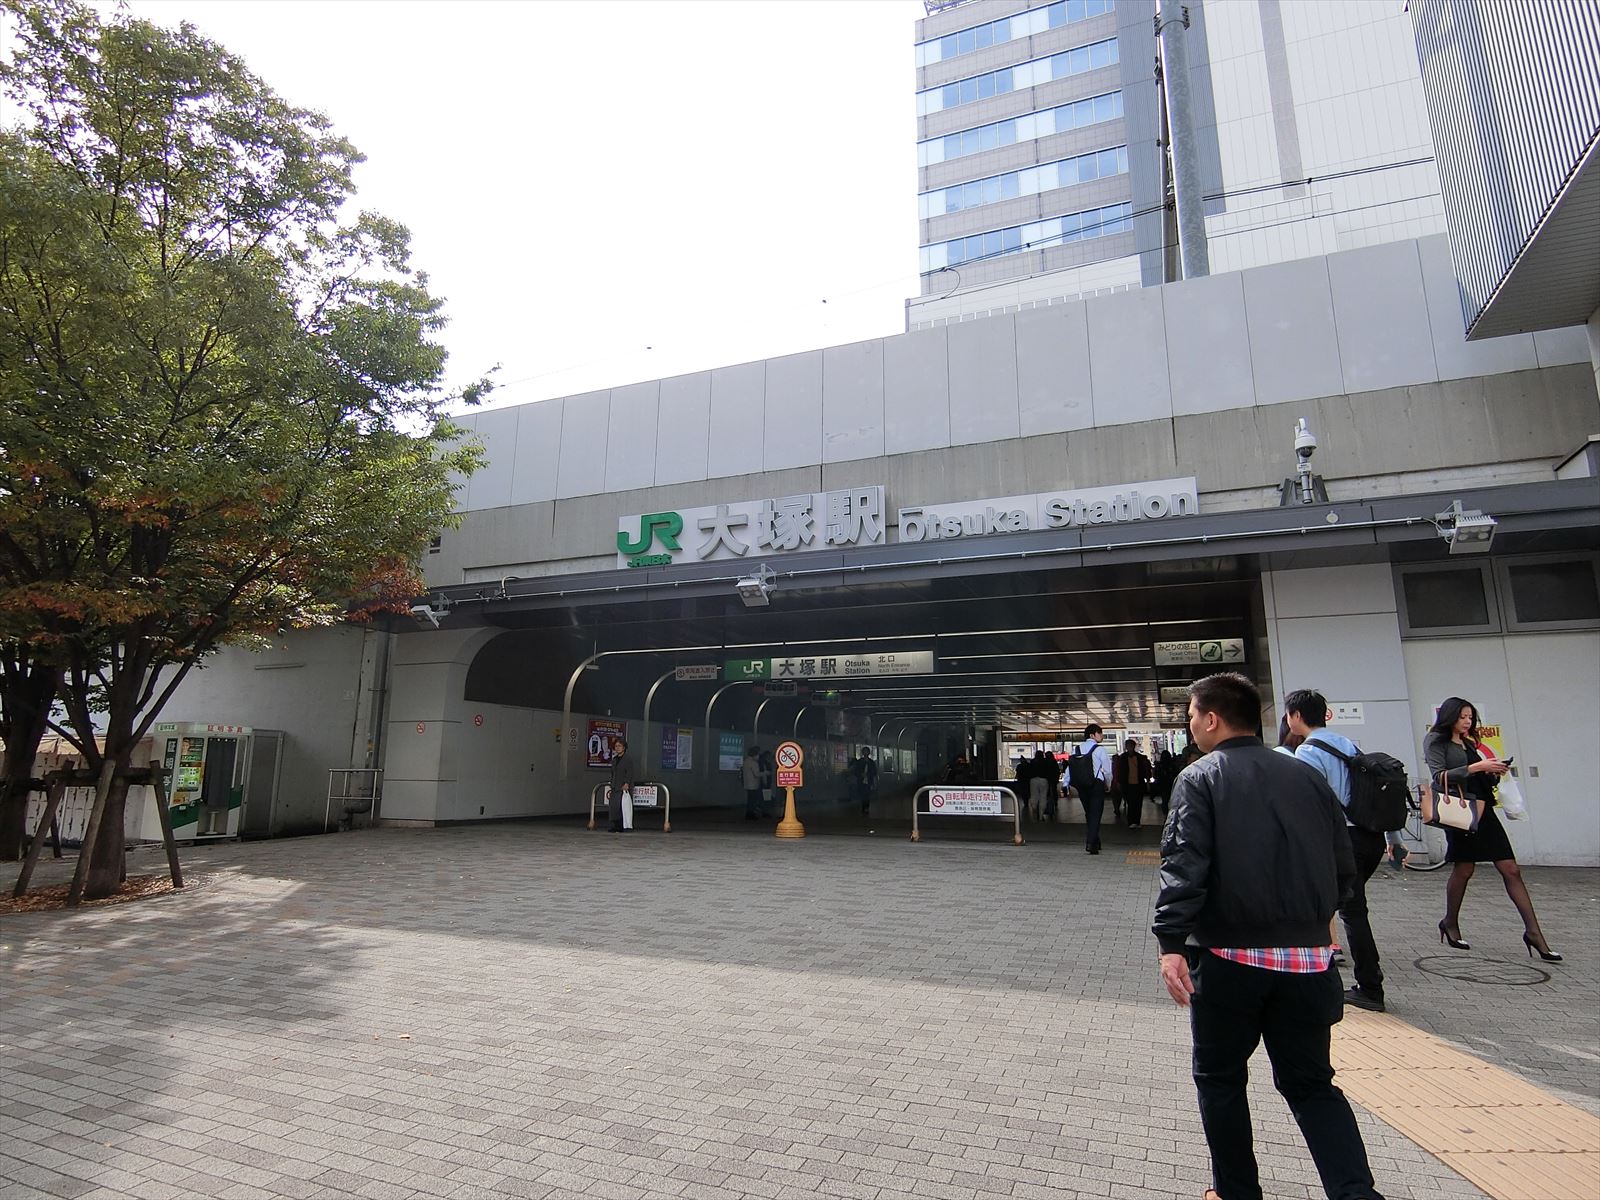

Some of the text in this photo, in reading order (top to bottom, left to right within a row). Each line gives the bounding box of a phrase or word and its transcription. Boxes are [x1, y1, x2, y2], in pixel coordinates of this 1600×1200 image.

[902, 490, 1196, 543] Ōtsuka Station
[697, 485, 884, 560] 大塚駅
[617, 511, 683, 554] JR
[1157, 642, 1198, 651] みどりの窓口
[878, 655, 895, 663] 北口
[743, 661, 763, 673] JR
[779, 658, 837, 677] 大塚駅
[845, 667, 871, 675] Station
[208, 724, 243, 733] 証明写真
[945, 792, 999, 801] 自転車走行禁止
